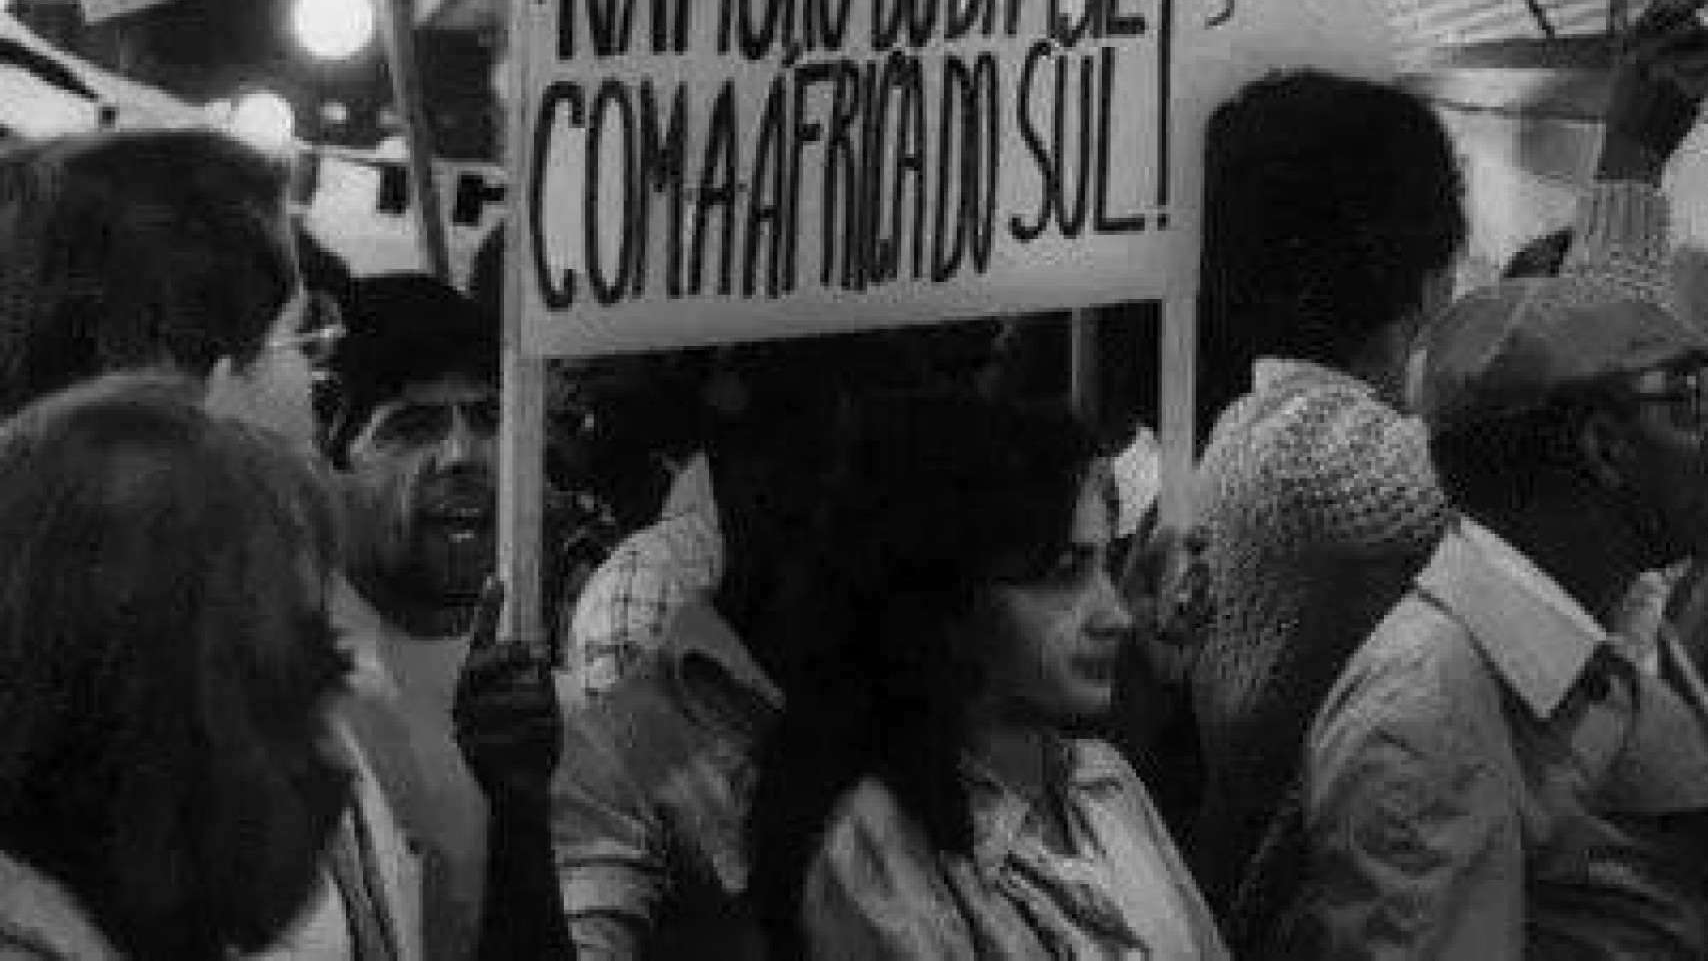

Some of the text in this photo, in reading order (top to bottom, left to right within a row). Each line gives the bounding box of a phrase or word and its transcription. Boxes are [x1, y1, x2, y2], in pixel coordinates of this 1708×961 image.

[530, 77, 690, 311] COM
[686, 77, 746, 299] A
[930, 51, 997, 284] DO
